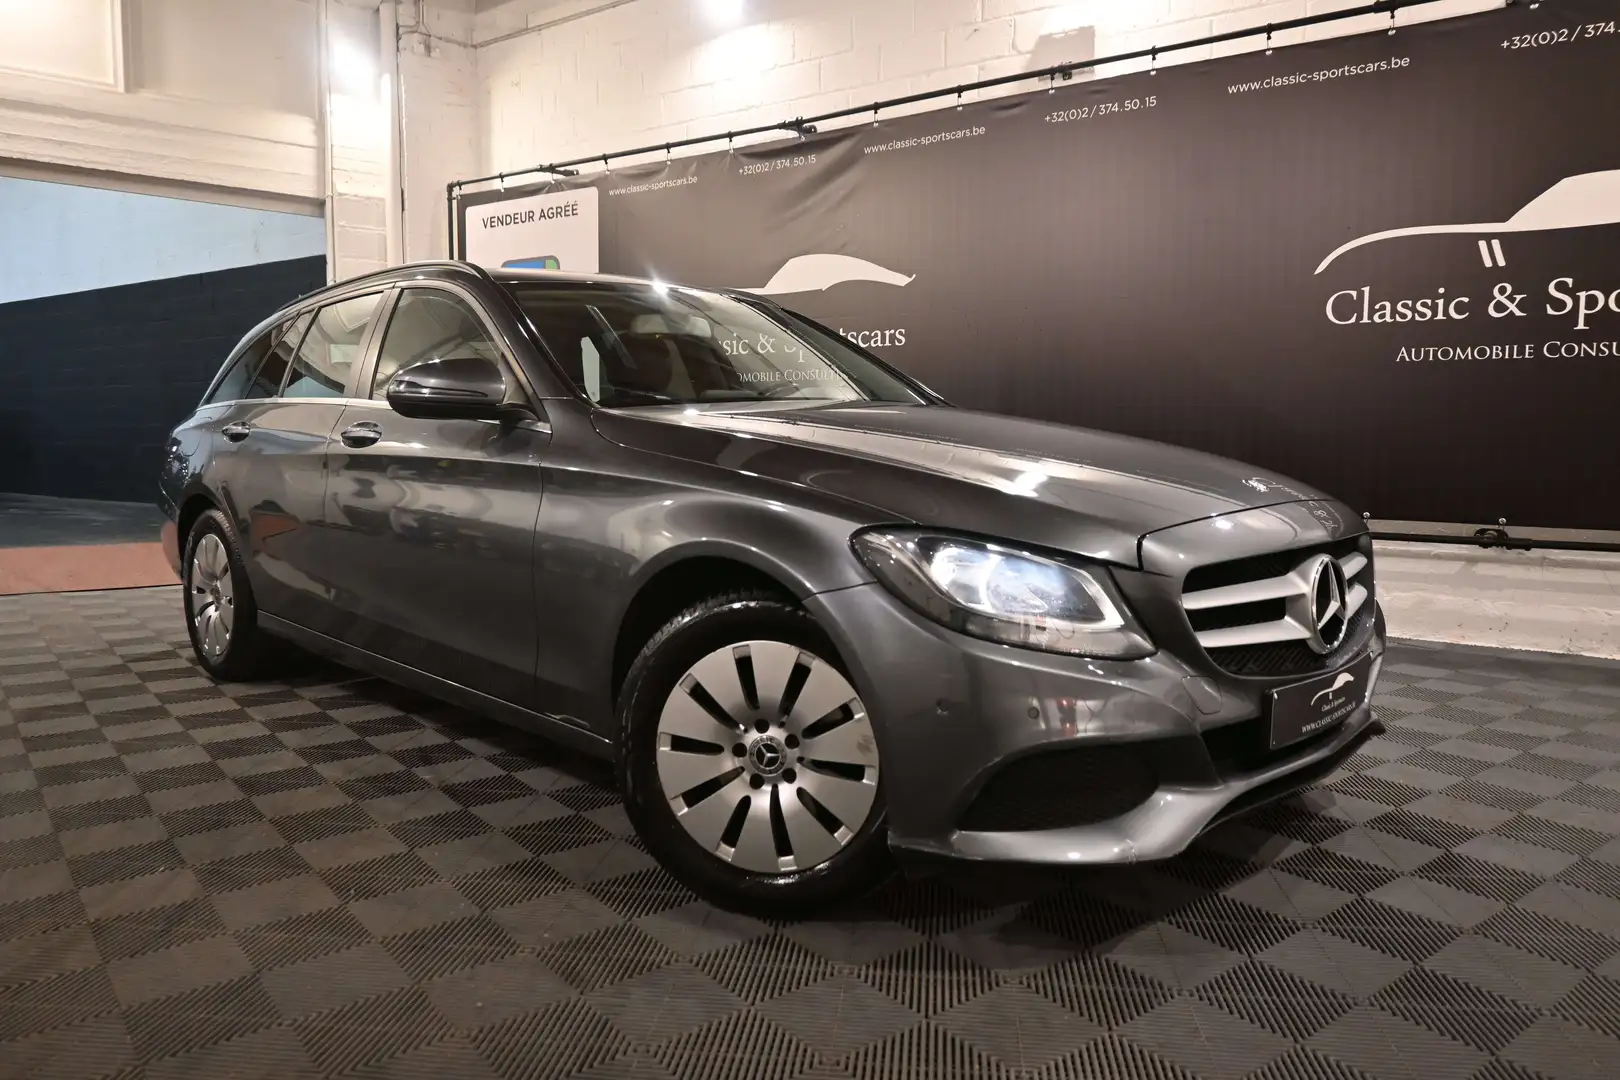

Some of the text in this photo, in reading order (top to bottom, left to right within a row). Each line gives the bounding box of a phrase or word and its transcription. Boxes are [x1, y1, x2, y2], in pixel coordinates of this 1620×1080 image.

[1227, 56, 1411, 94] www.classic-sportscars.be
[863, 125, 987, 154] www.classic-sportscars.be
[608, 175, 699, 197] www.classic-sportscars.be
[482, 200, 579, 230] VENDEUR AGRÉÉ
[1325, 286, 1470, 325] Classic
[1487, 282, 1527, 318] &
[719, 332, 749, 356] sic
[757, 333, 776, 354] &
[1396, 344, 1535, 362] AUTOMOBILE
